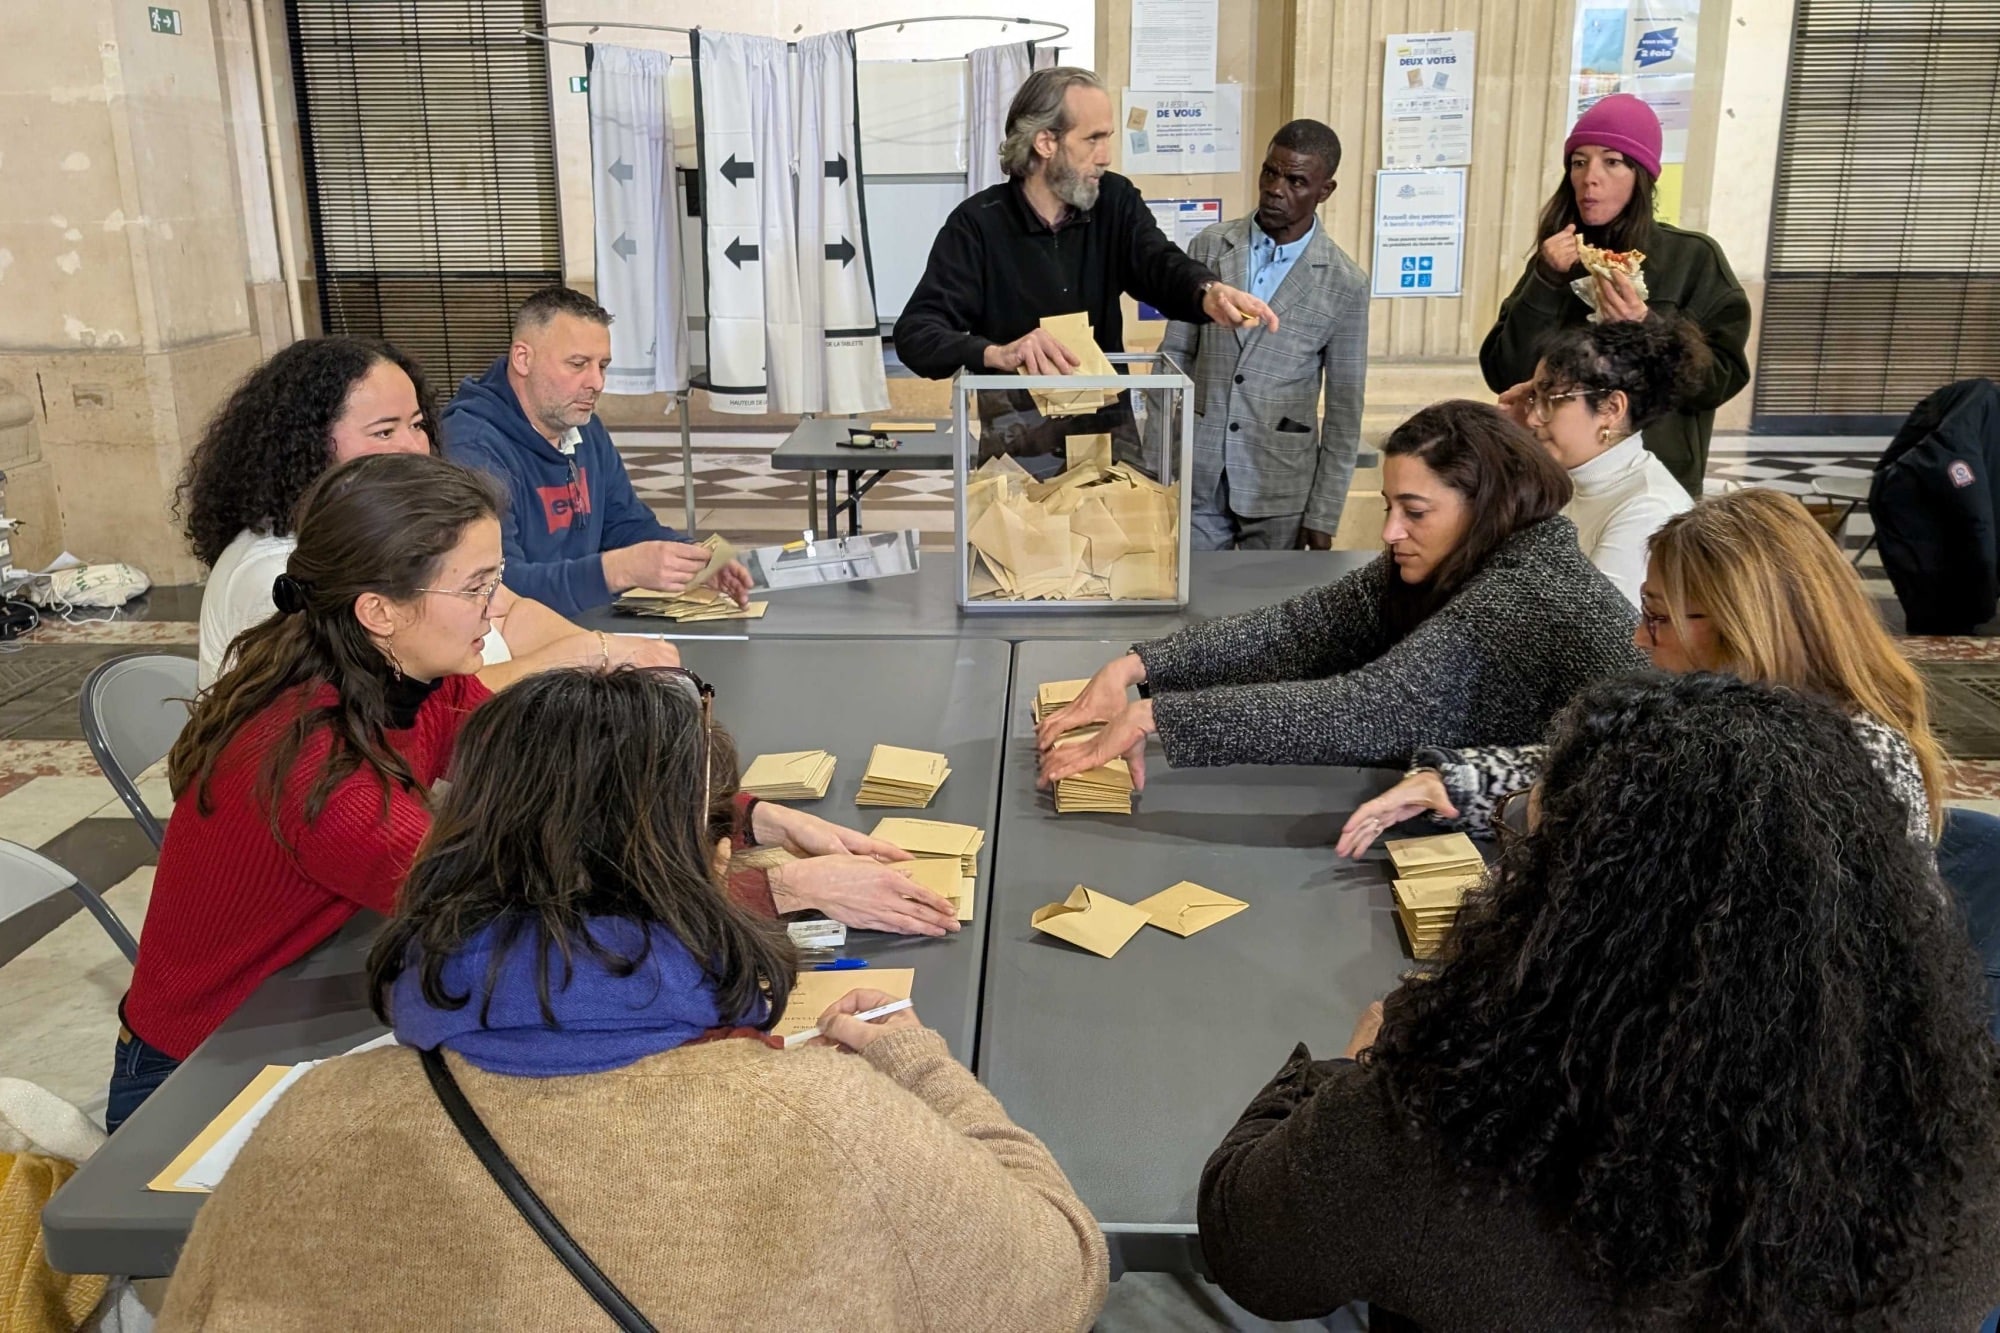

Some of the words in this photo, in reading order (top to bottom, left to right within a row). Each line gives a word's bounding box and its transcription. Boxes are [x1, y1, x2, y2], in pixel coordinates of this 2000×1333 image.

[1640, 49, 1649, 57] 2
[1649, 48, 1672, 57] fois
[1400, 57, 1423, 66] DEUX
[1426, 55, 1457, 65] VOTES
[1156, 109, 1170, 118] DE
[1173, 108, 1202, 118] VOUS
